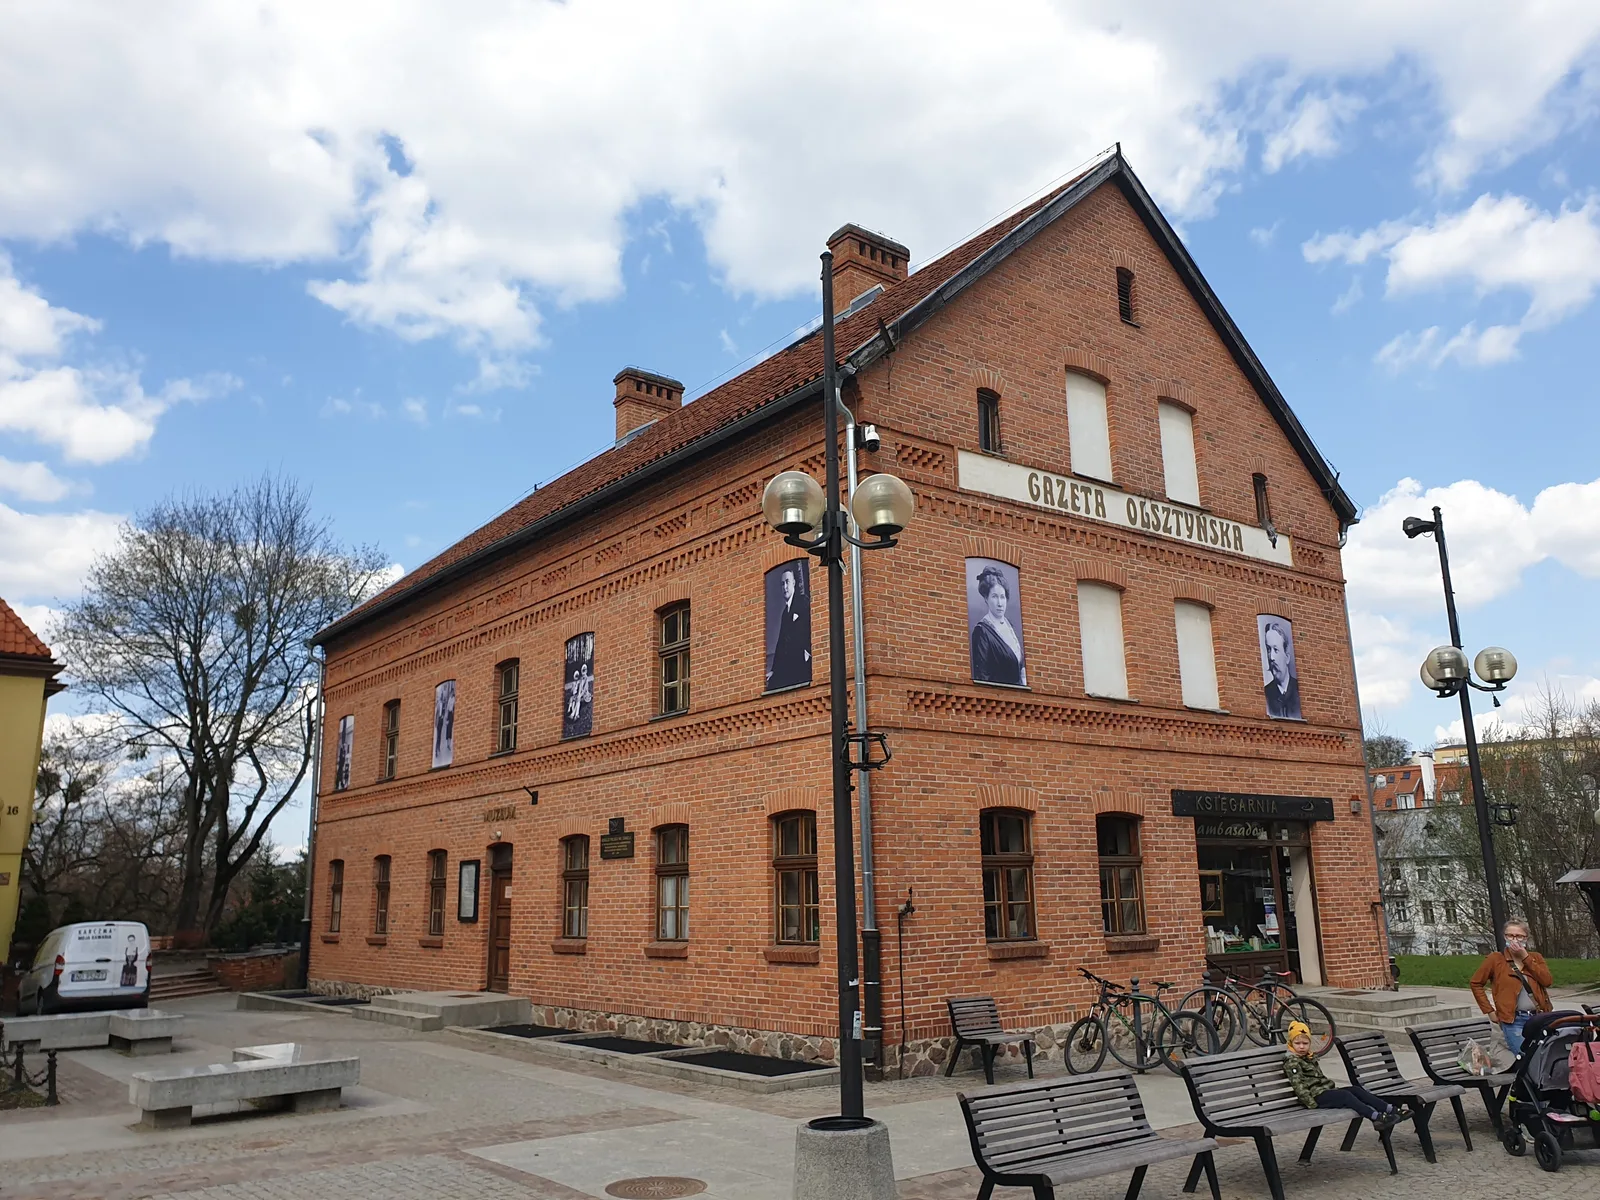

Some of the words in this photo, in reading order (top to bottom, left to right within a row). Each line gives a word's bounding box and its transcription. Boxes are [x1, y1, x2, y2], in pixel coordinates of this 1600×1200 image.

[1027, 471, 1107, 519] GAZETA
[1126, 496, 1245, 552] OLSZTYŃSKA
[7, 806, 19, 815] 16
[1195, 795, 1278, 814] KSIĘGARNIA
